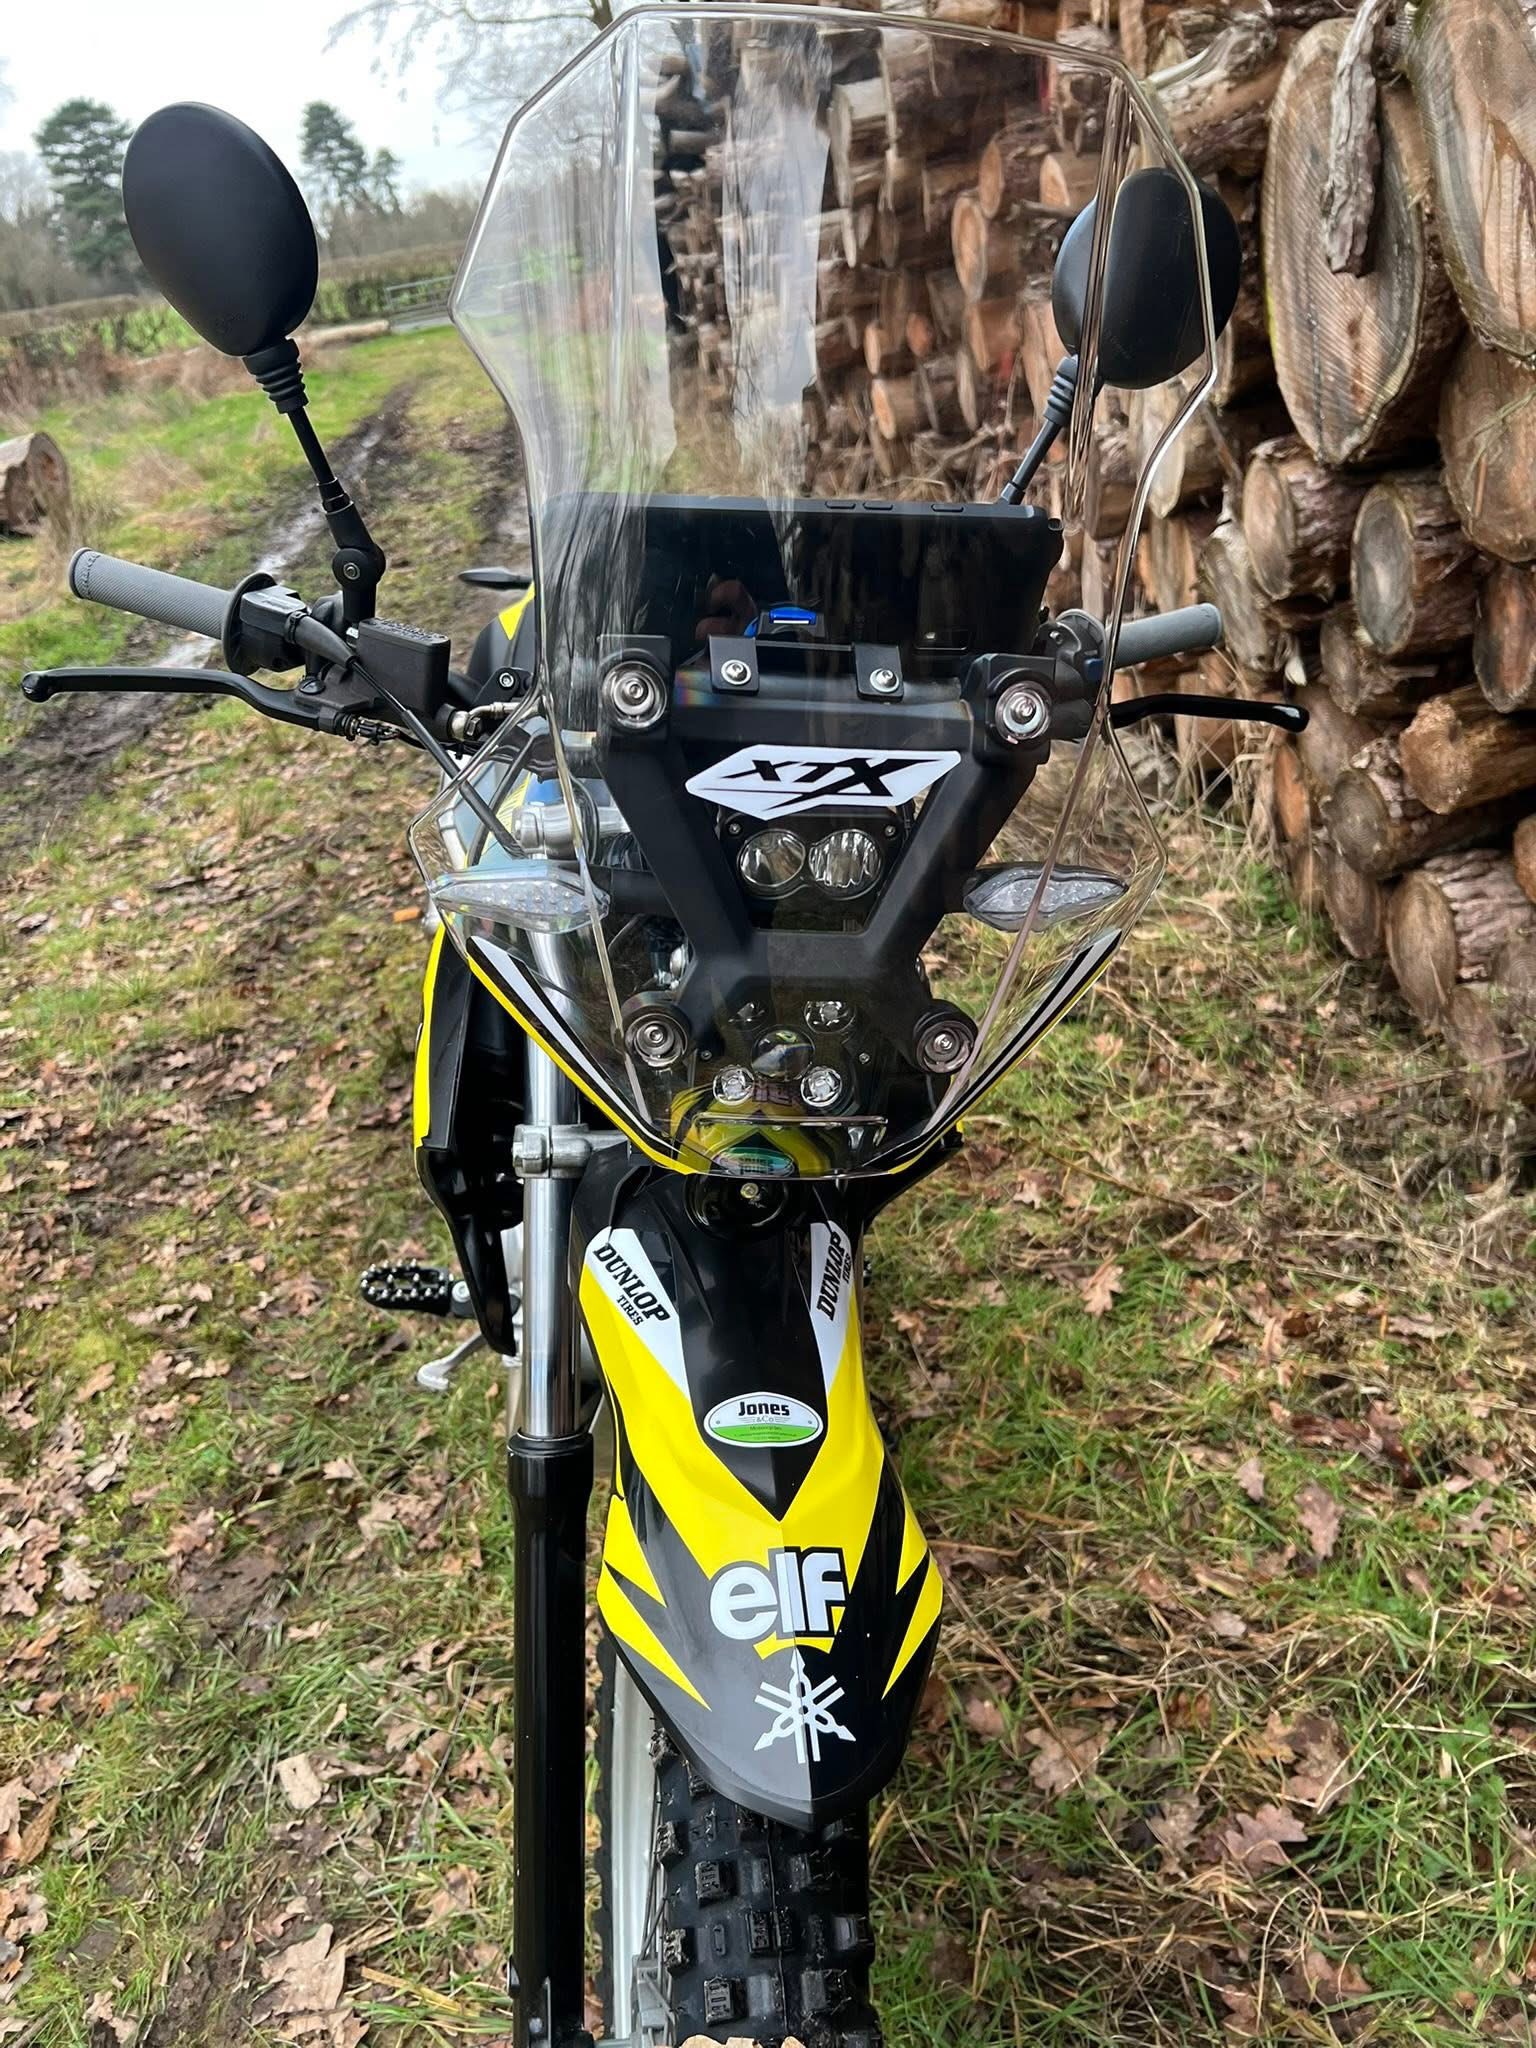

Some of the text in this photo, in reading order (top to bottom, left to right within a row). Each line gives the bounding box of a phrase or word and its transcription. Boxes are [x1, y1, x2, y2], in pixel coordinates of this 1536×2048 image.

[718, 757, 942, 812] XTX
[592, 1242, 671, 1321] DUNLOP
[616, 1294, 644, 1326] TIRES
[816, 1231, 845, 1322] DUNLOP
[738, 1401, 790, 1417] Jones
[710, 1551, 846, 1641] elf
